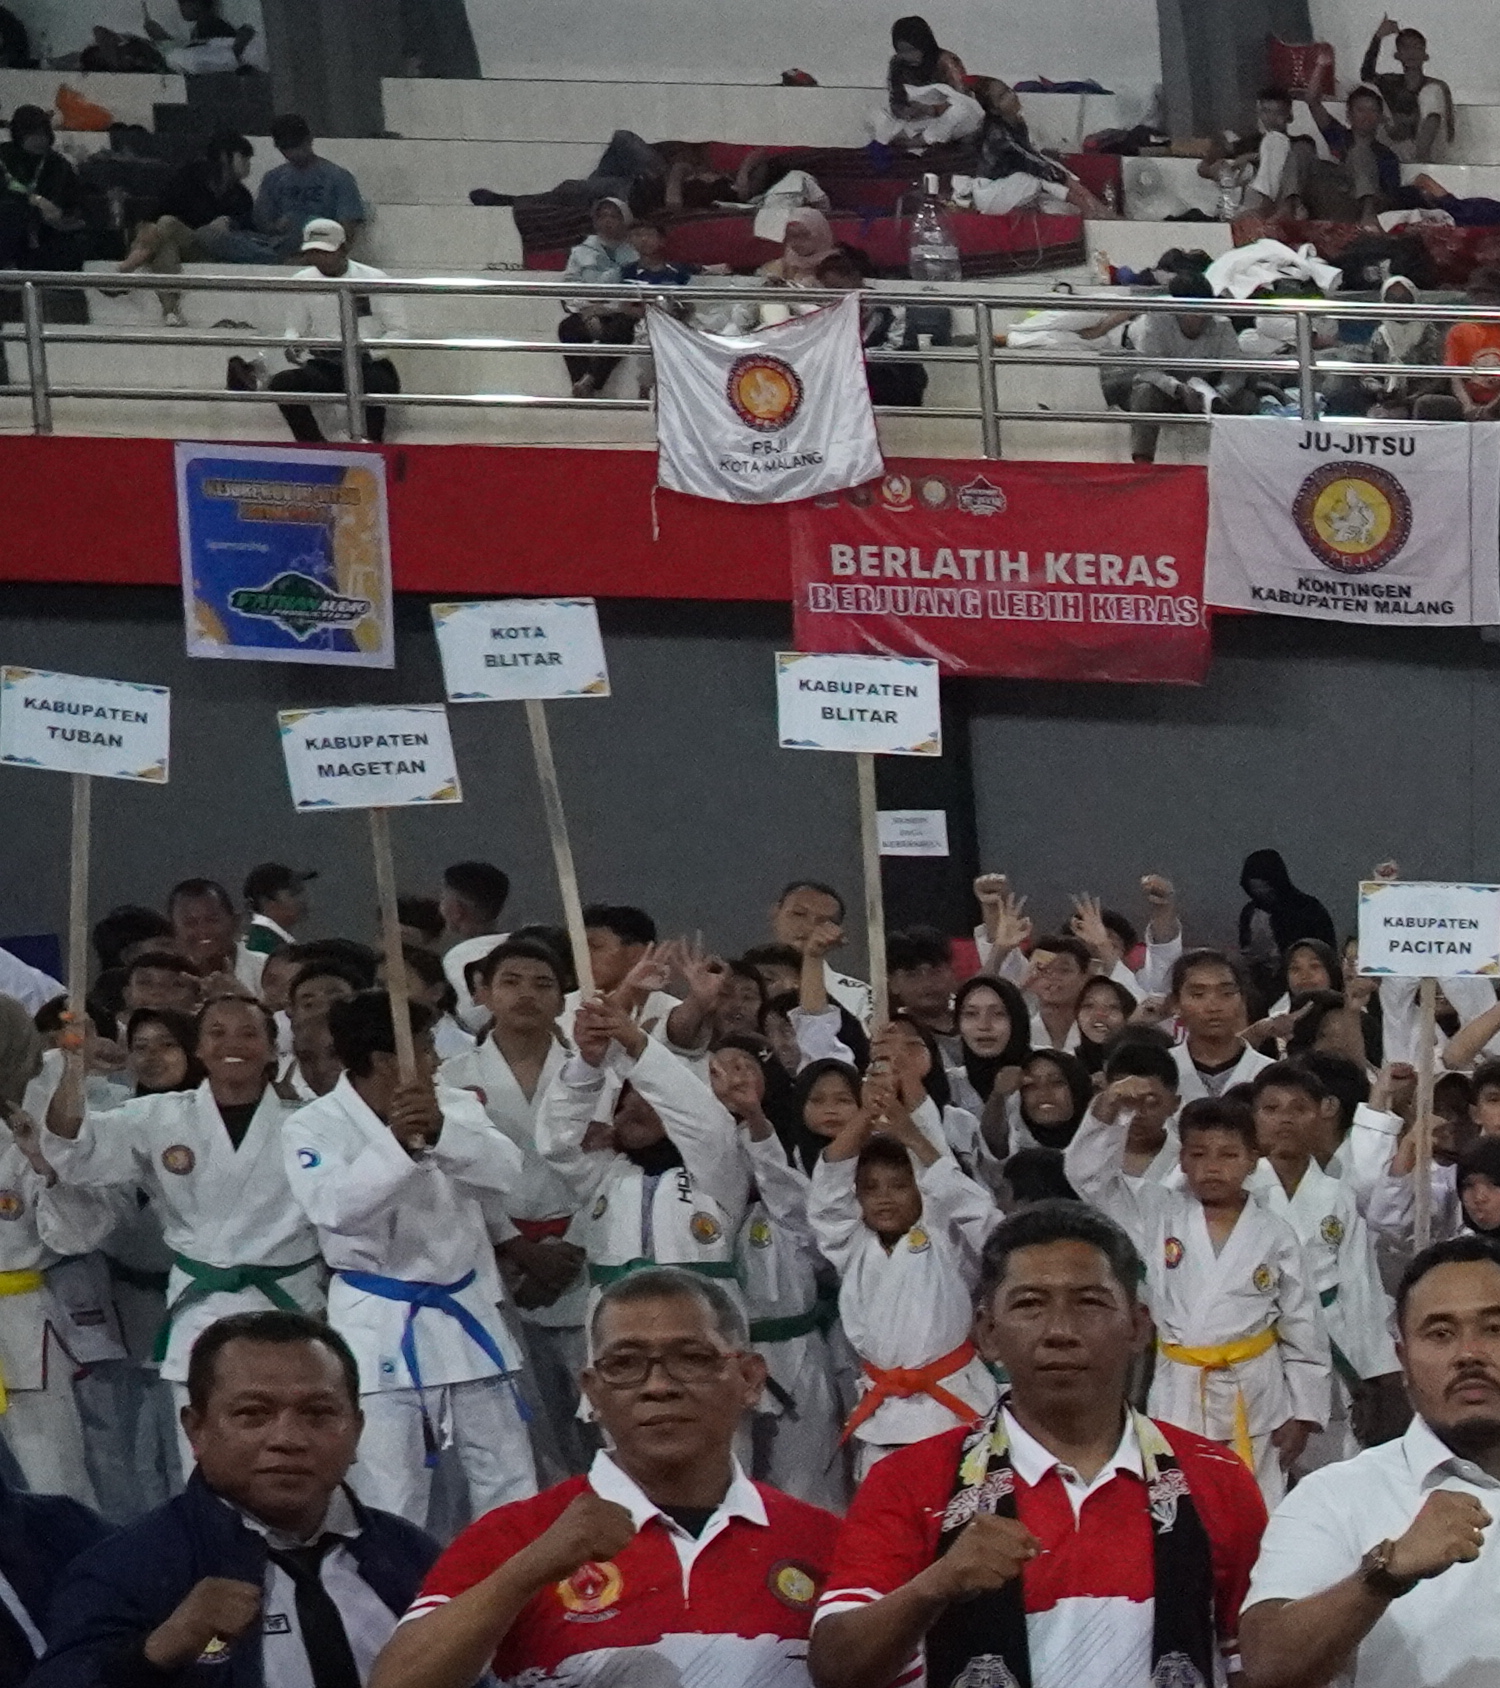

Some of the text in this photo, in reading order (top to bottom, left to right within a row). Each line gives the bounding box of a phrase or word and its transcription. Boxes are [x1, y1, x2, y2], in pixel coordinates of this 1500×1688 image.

[1299, 431, 1416, 457] JU-JITSU
[719, 457, 759, 473] KOTA
[830, 542, 1180, 589] BERLATIH KERAS
[1298, 577, 1412, 599] KONTINGEN
[808, 582, 1201, 627] BERJUANG LEBIH KERAS
[1251, 586, 1455, 616] KABUPATEN MALANG
[490, 625, 548, 641] KOTA
[484, 651, 563, 669] BLITAR
[798, 678, 919, 699] KABUPATEN
[23, 695, 149, 725] KABUPATEN
[821, 705, 899, 725] BLITAR
[47, 725, 124, 749] TUBAN
[305, 732, 430, 752] KABUPATEN
[317, 758, 427, 778] MAGETAN
[1383, 915, 1479, 931] KABUPATEN
[1389, 939, 1472, 955] PACITAN
